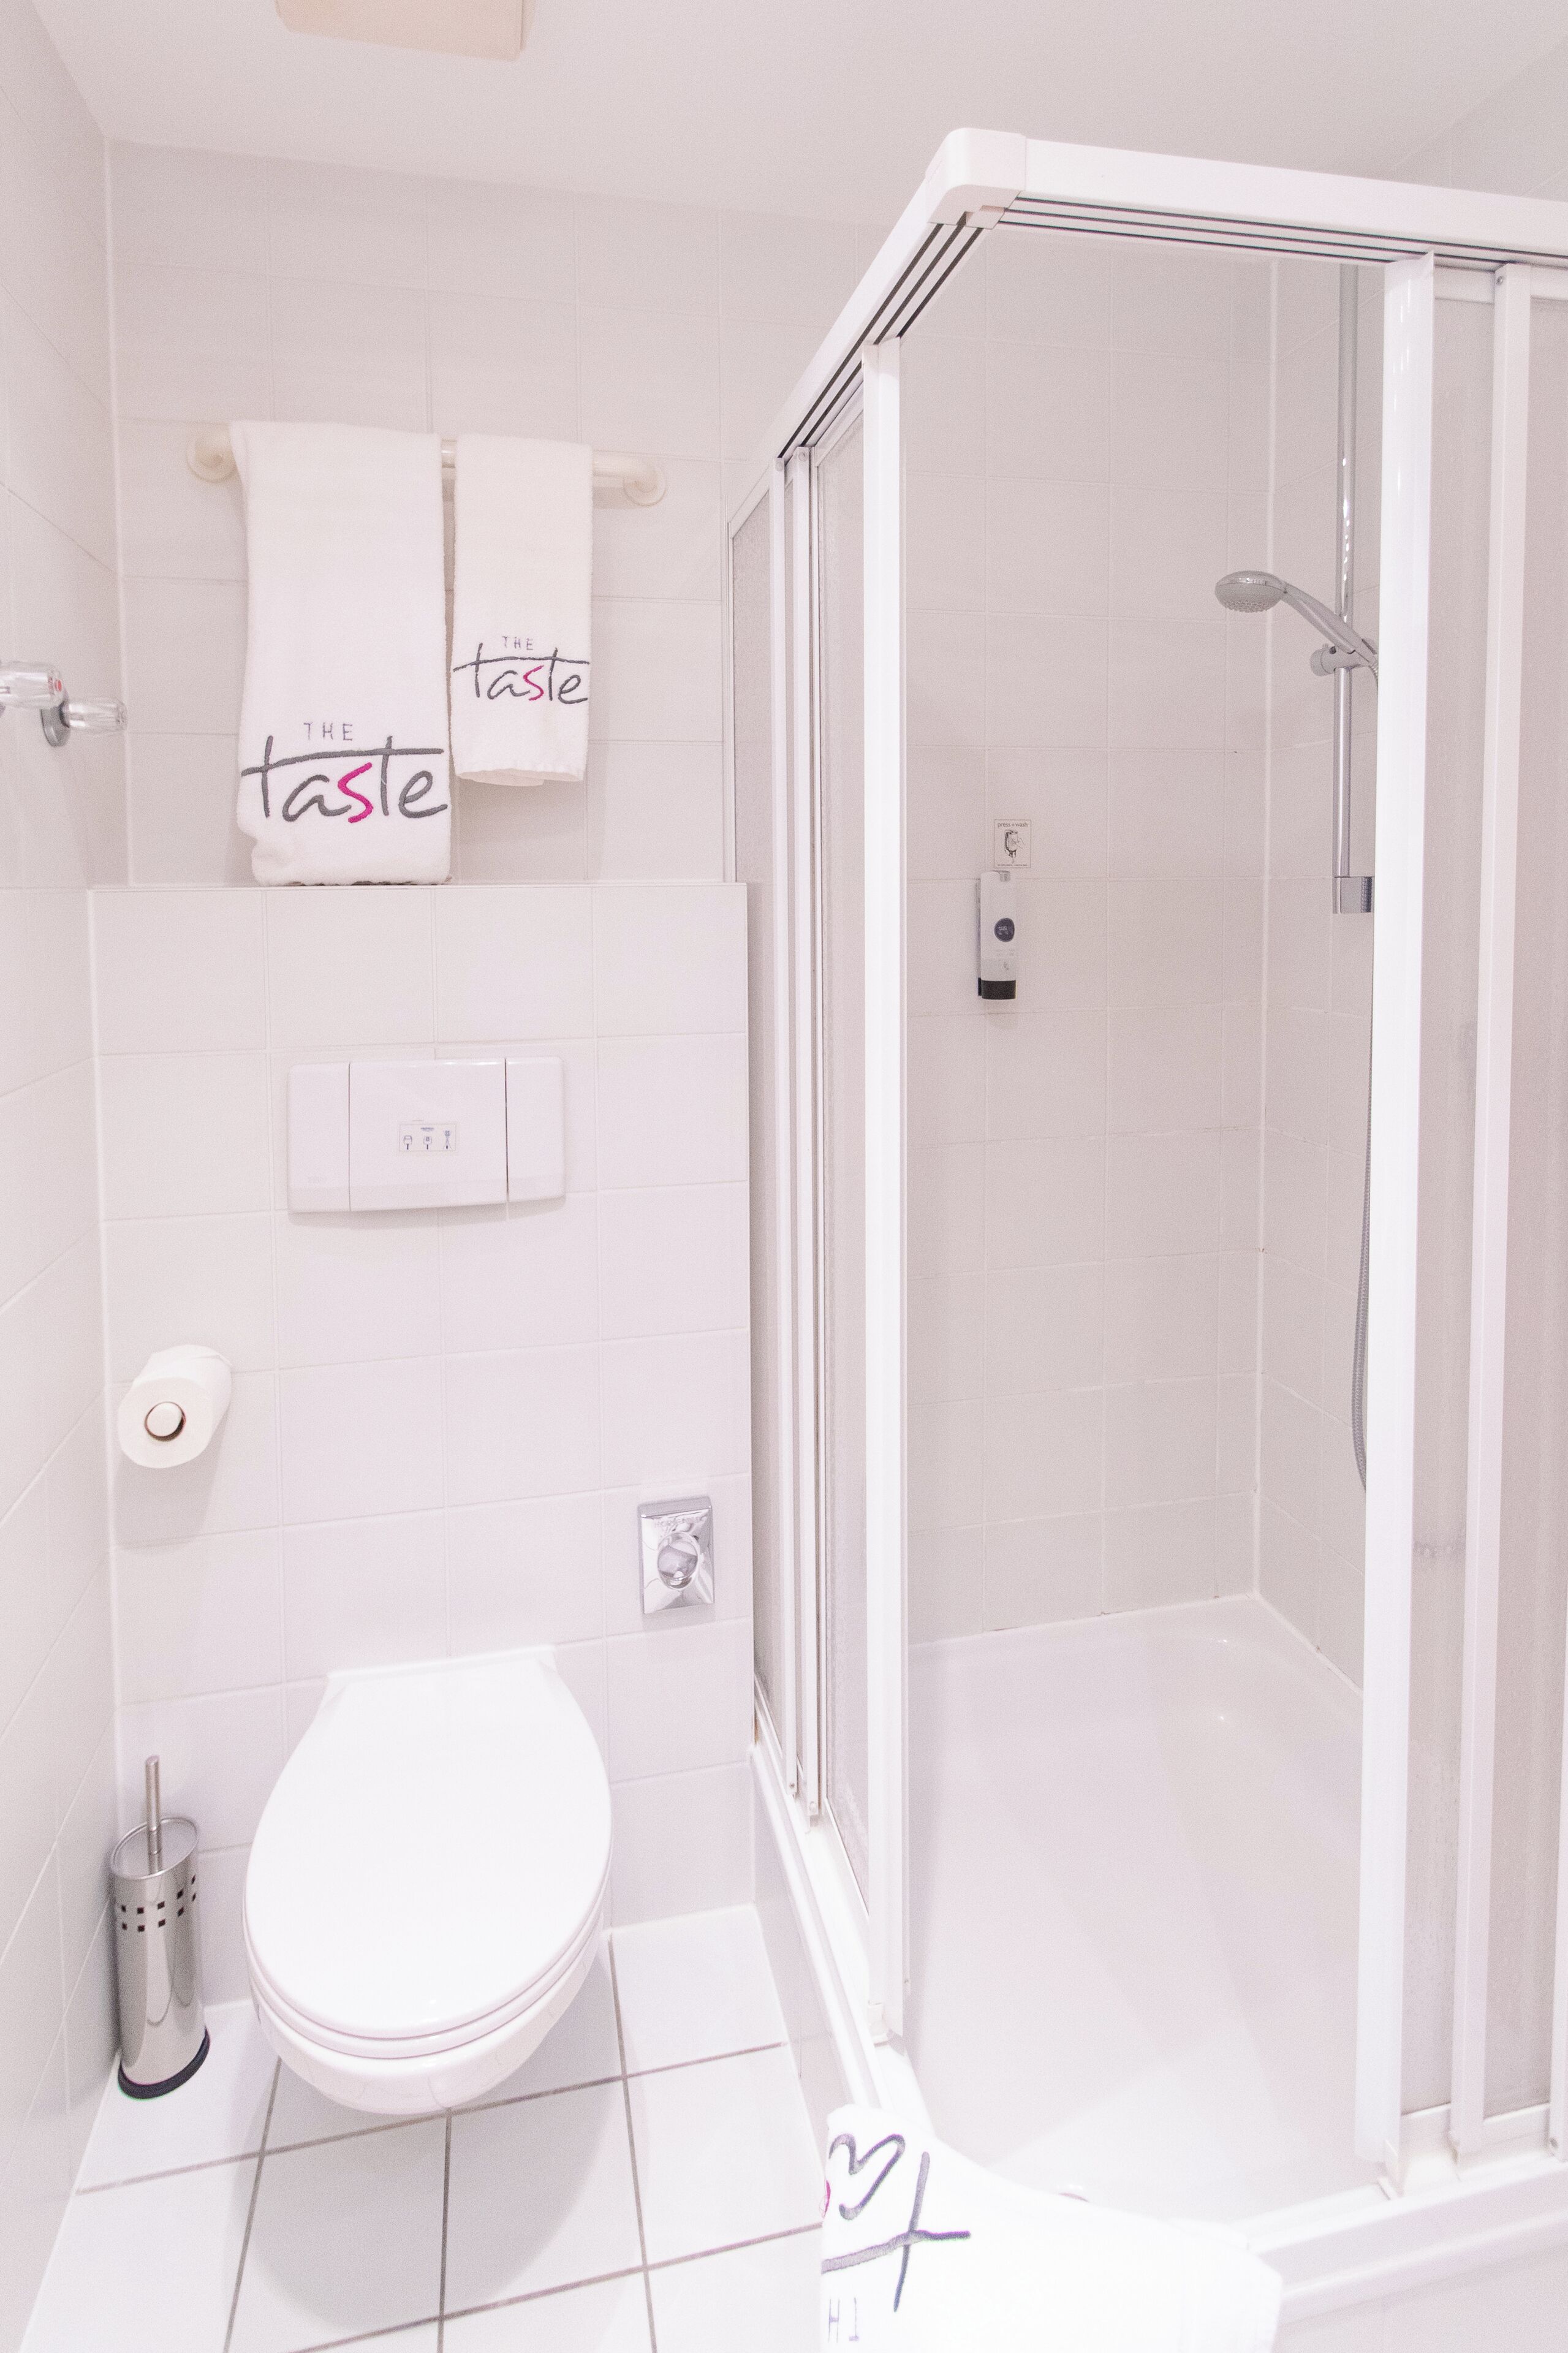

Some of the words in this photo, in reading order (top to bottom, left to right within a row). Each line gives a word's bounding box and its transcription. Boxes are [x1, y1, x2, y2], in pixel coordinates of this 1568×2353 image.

[502, 635, 534, 651] THE
[452, 643, 590, 704] taste
[303, 722, 354, 741] THE
[241, 735, 448, 824] taste
[827, 2297, 860, 2344] TH
